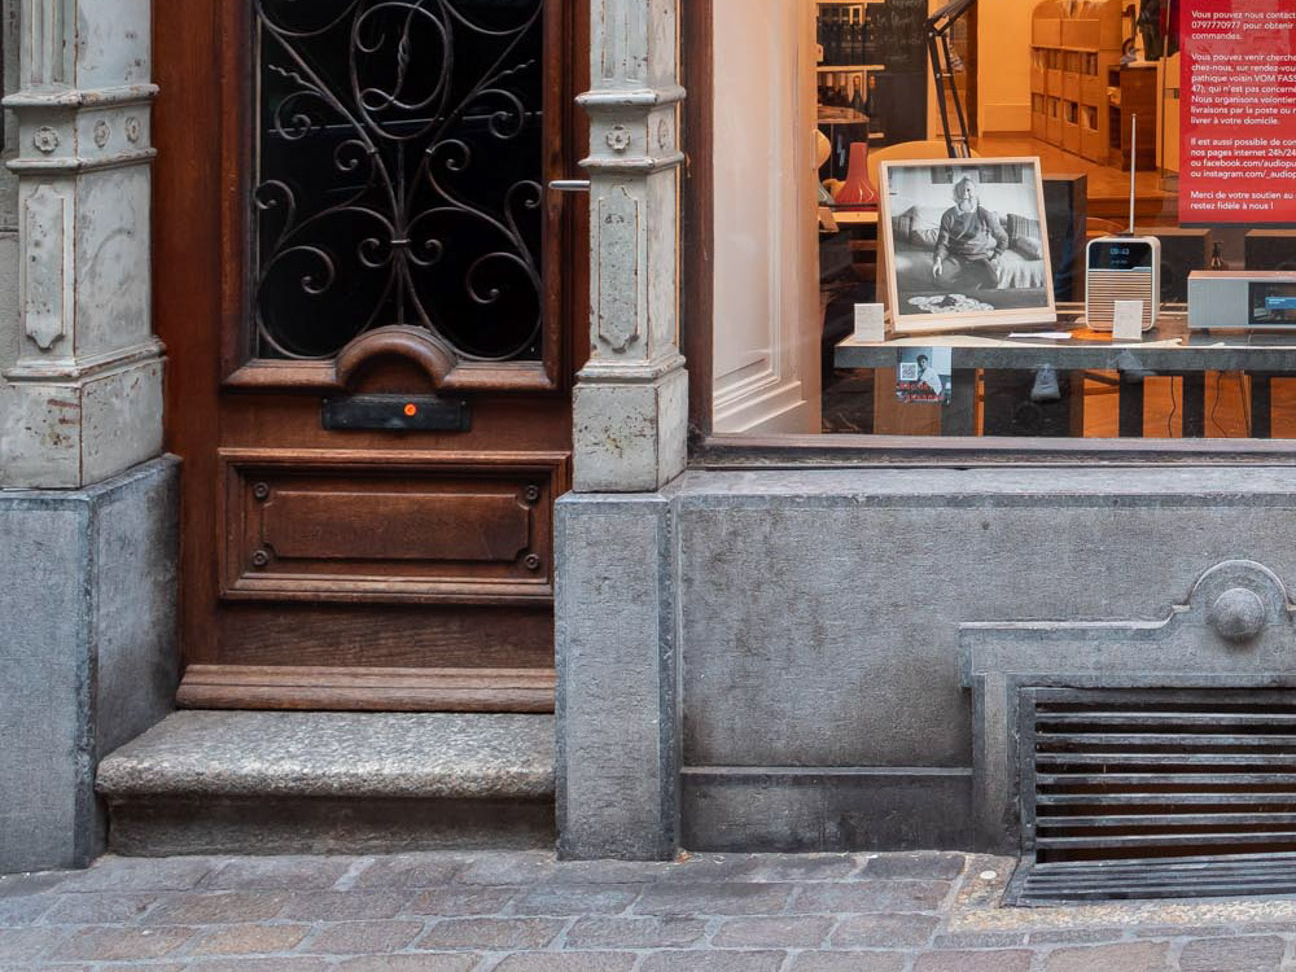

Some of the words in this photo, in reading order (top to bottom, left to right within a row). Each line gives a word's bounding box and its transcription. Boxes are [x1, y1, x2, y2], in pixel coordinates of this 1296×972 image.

[1192, 10, 1211, 19] Vous
[1212, 13, 1242, 21] pouvez
[1190, 95, 1212, 103] Nous
[1214, 95, 1258, 105] organisons
[1190, 106, 1228, 114] livraisons
[1230, 108, 1243, 116] par
[1254, 106, 1278, 116] poste
[1190, 116, 1211, 124] livrer
[1220, 116, 1242, 124] votre
[1243, 116, 1280, 124] domicile.
[1197, 137, 1210, 146] est
[1212, 137, 1233, 146] aussi
[1234, 137, 1268, 148] possible
[1207, 150, 1232, 158] pages
[1234, 148, 1266, 156] internet
[1268, 148, 1296, 158] 24h/24
[1190, 190, 1214, 198] Merci
[1228, 190, 1250, 199] votre
[1251, 190, 1281, 199] soutien
[1190, 201, 1215, 209] restez
[1217, 201, 1240, 209] fidèle
